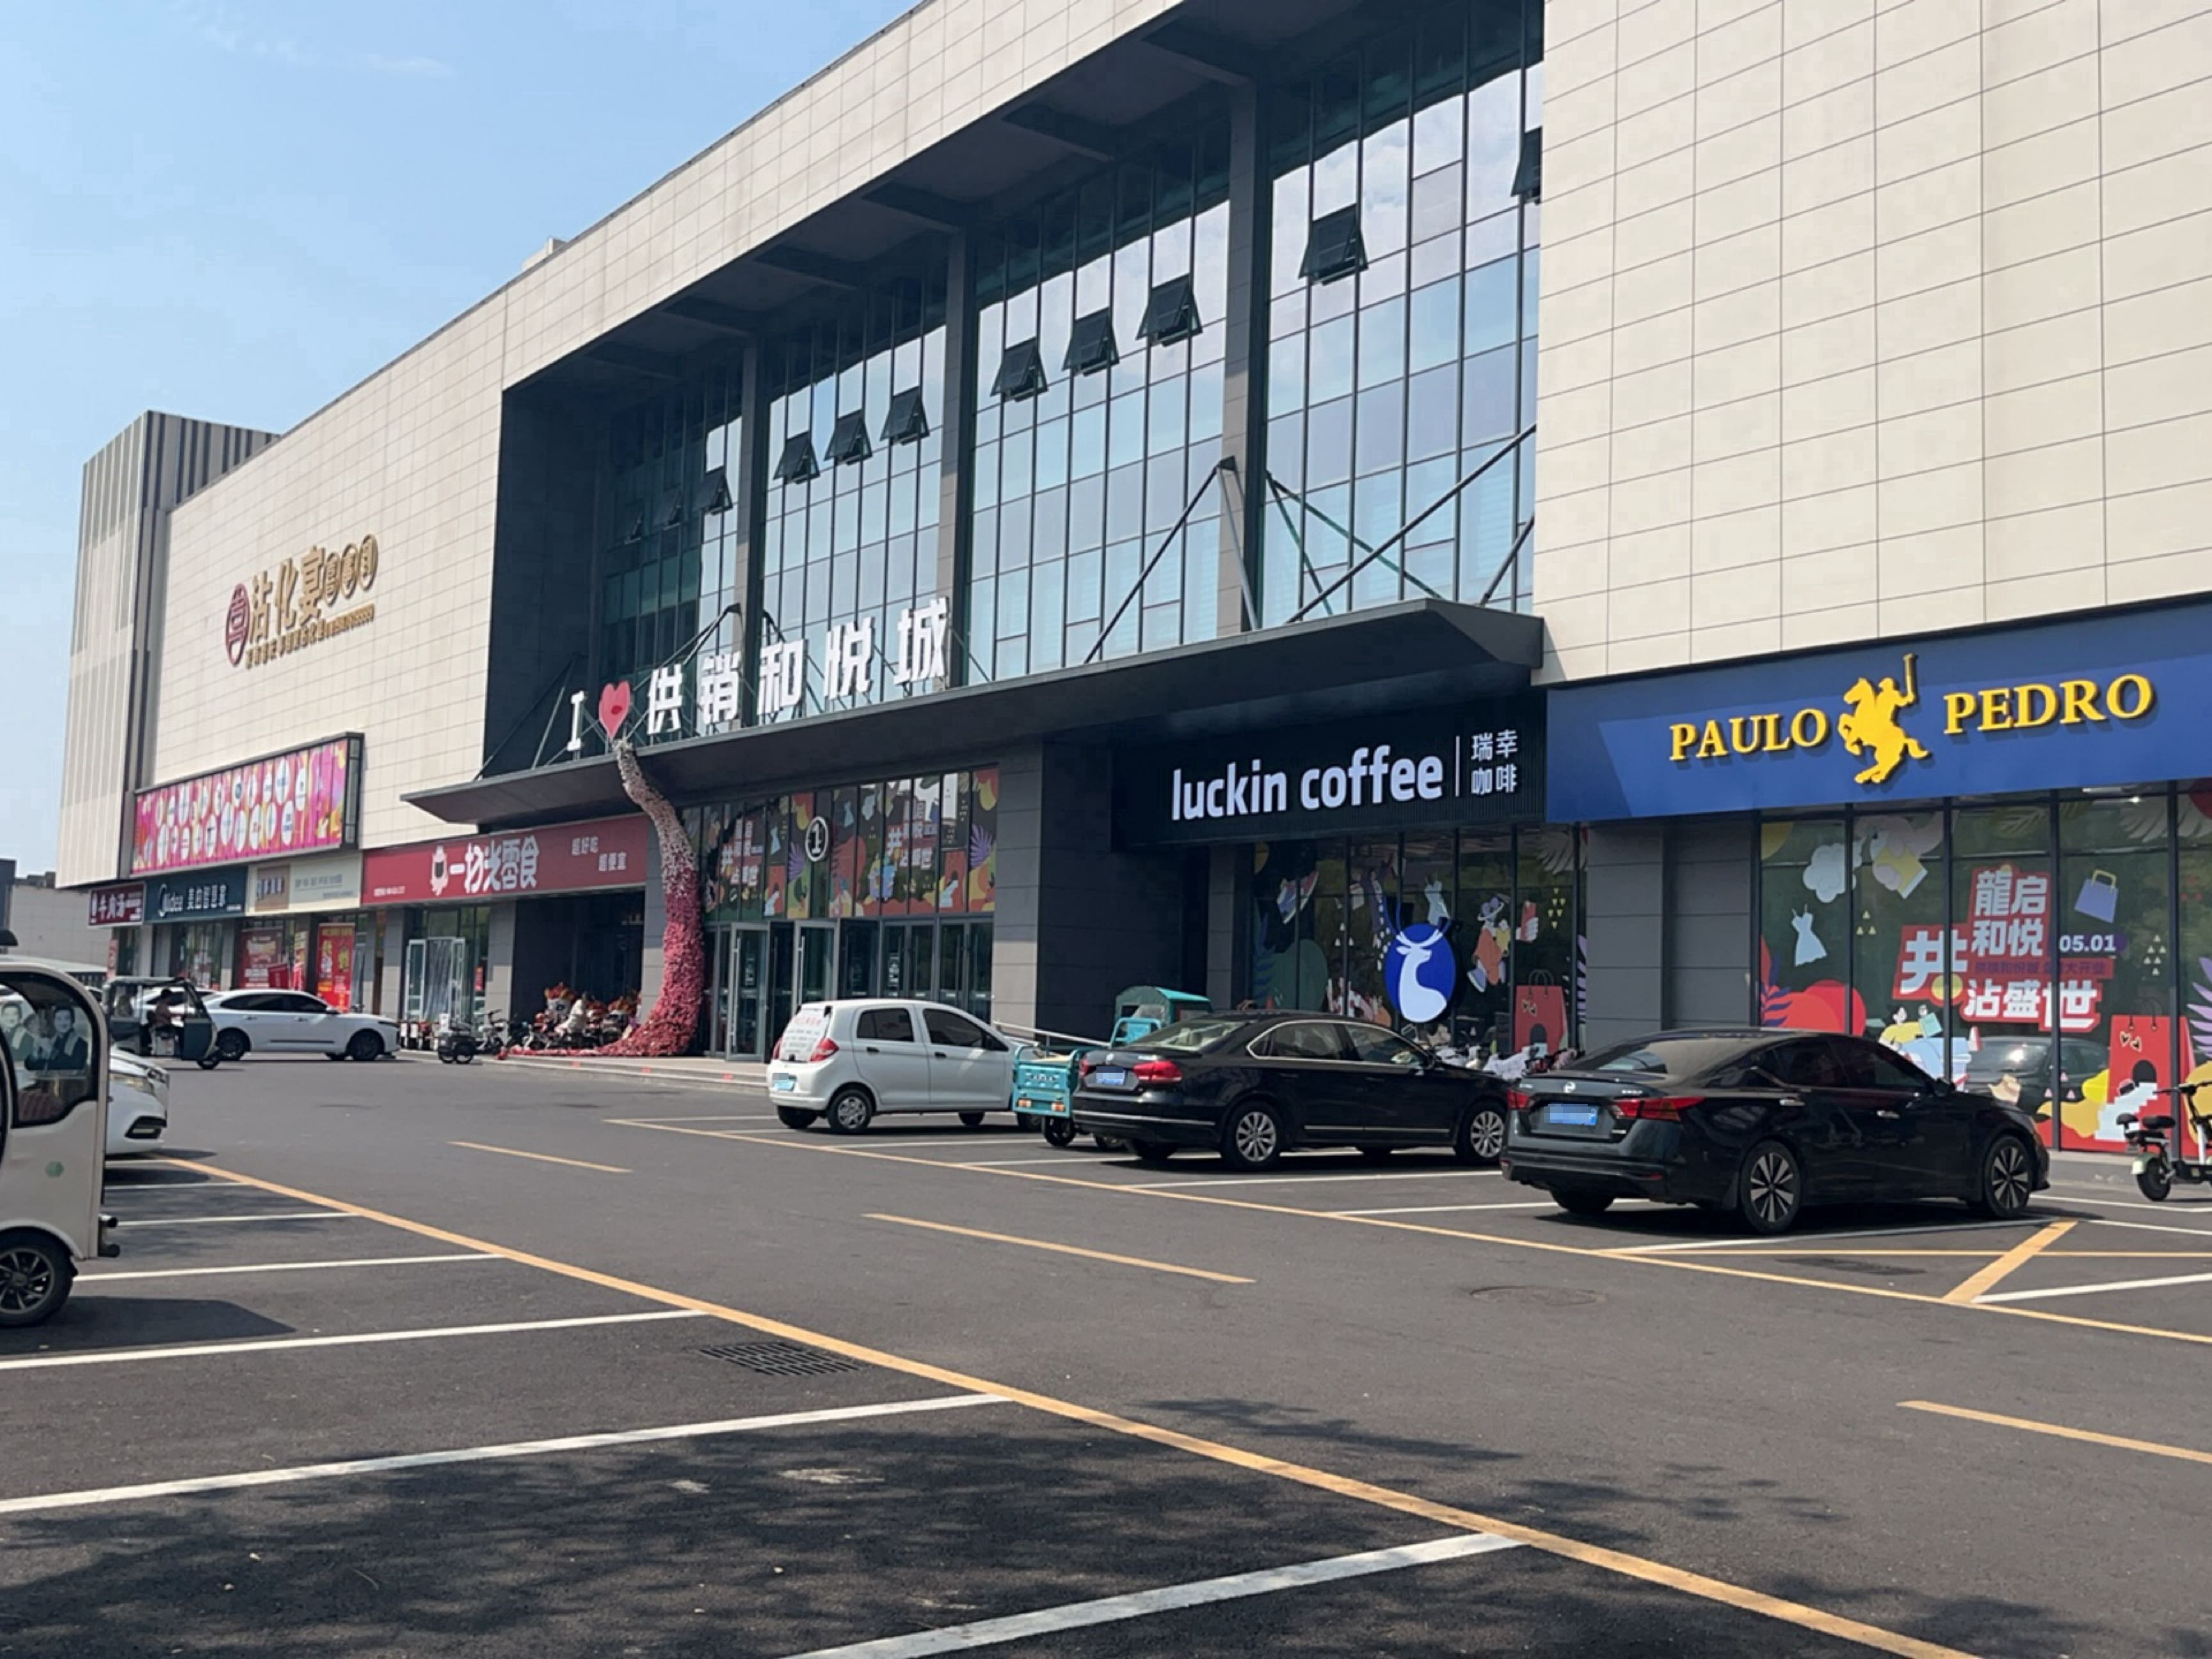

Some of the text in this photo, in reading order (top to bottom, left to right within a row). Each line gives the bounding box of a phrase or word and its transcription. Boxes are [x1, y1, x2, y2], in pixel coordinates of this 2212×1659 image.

[249, 545, 326, 644] 沾化宴
[566, 597, 950, 751] I 供销和悦城
[1669, 673, 2156, 761] PAULO PEDRO
[1471, 730, 1518, 761] 瑞幸
[1171, 744, 1443, 821] luckin coffee
[1471, 764, 1518, 796] 咖啡
[1975, 870, 2048, 917] 龍启
[1900, 930, 1968, 995] 共
[1971, 918, 2044, 958] 和悦
[2059, 934, 2116, 952] 05.01
[1964, 978, 2097, 1028] 沾盛世
